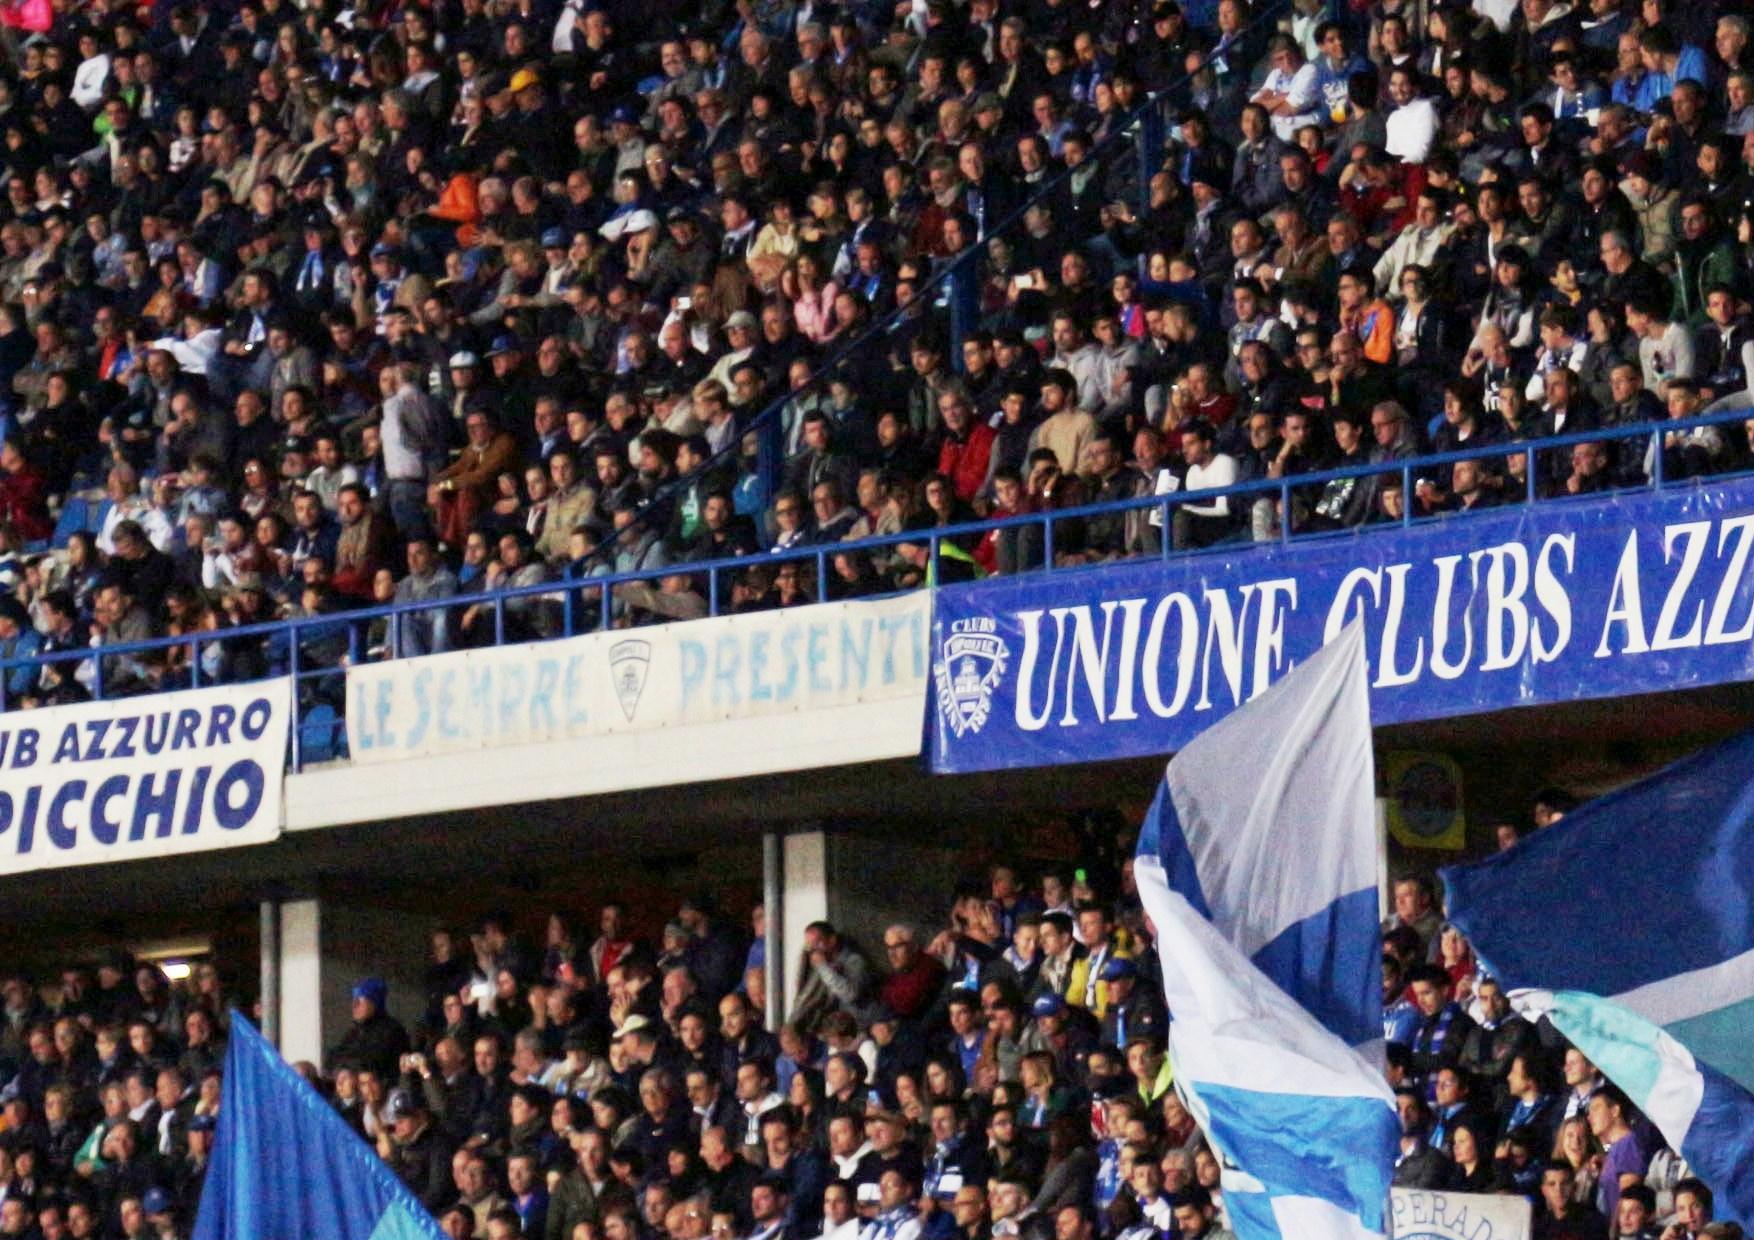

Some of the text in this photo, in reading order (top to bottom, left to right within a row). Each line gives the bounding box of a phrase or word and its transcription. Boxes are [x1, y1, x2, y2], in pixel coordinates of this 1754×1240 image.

[406, 654, 589, 748] SEMPRE
[677, 608, 925, 712] PRESENTI
[1015, 577, 1299, 731] UNIONE
[1323, 532, 1576, 689] CLUBS
[51, 698, 272, 764] AZZURRO
